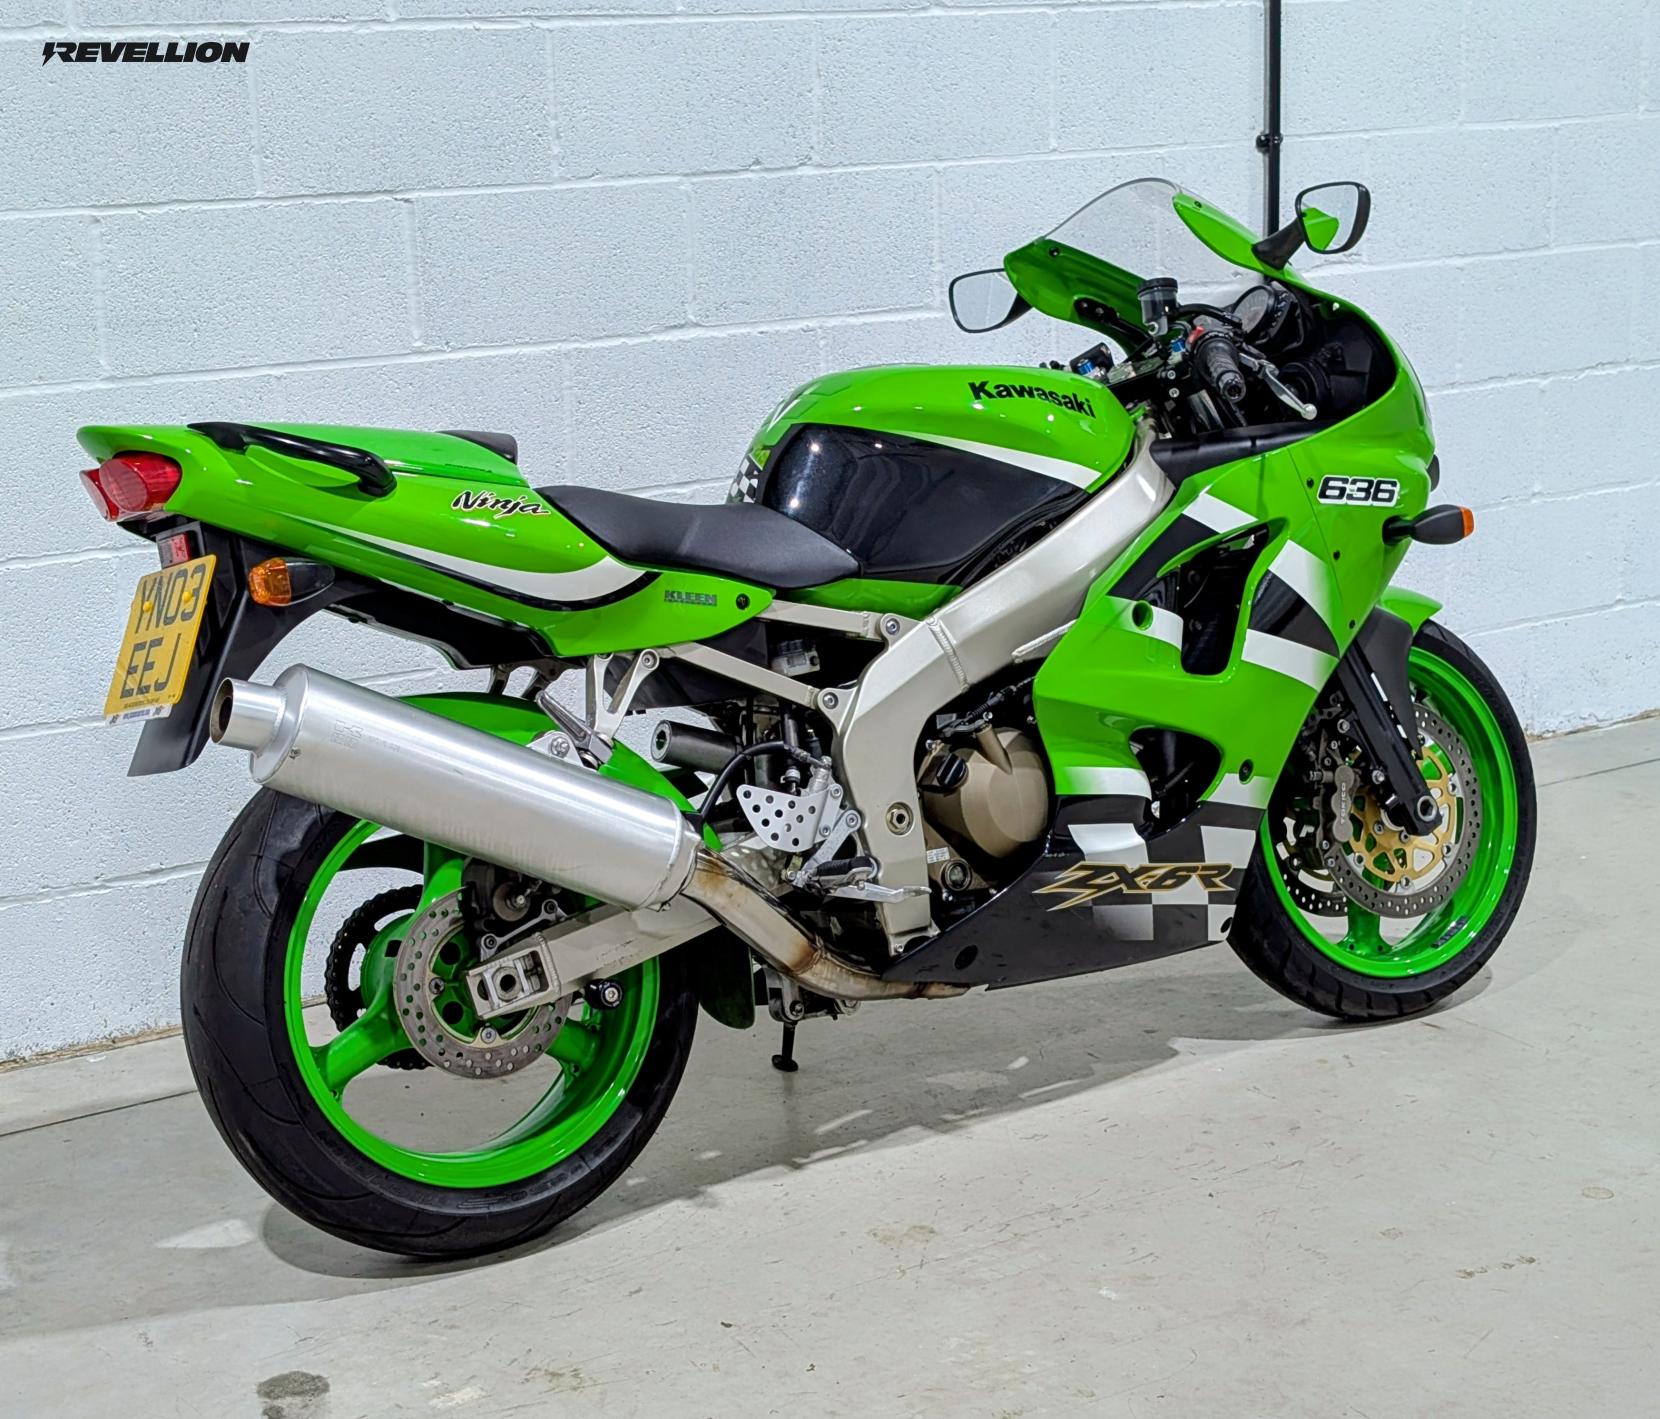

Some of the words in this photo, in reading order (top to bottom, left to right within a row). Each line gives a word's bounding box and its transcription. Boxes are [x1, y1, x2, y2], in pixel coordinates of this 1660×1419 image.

[968, 381, 1096, 419] Kawasaki
[451, 490, 551, 519] Ninja
[1318, 475, 1399, 506] 636
[135, 563, 206, 634] YN03
[120, 632, 181, 699] EEJ
[1032, 861, 1236, 912] ZX-6R
